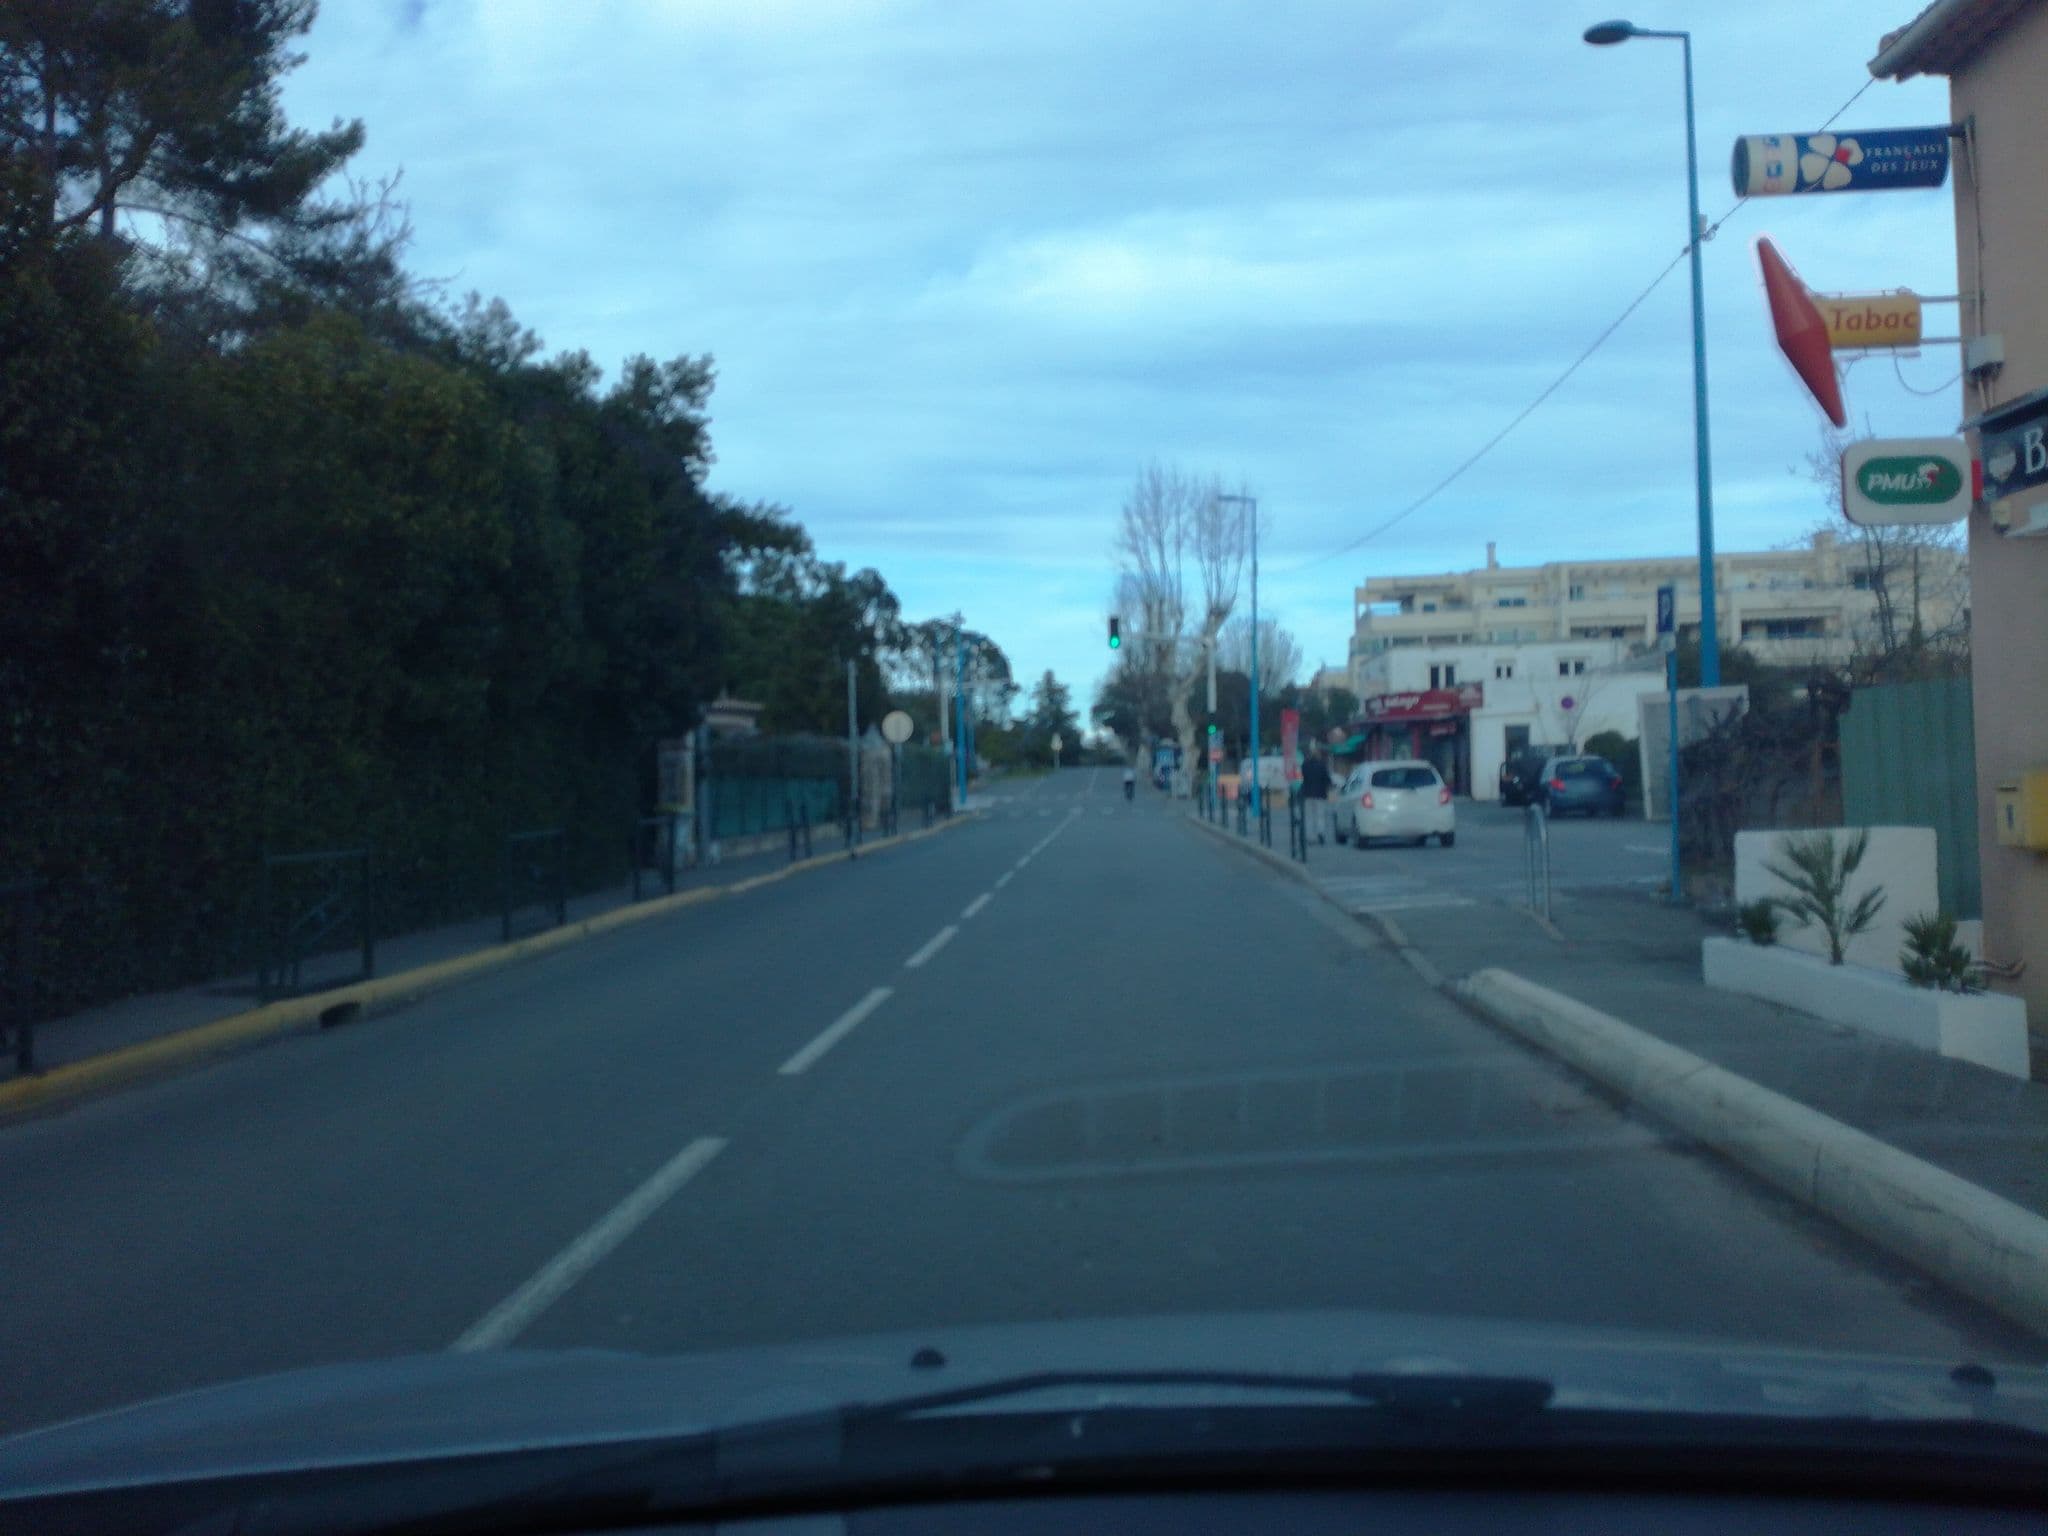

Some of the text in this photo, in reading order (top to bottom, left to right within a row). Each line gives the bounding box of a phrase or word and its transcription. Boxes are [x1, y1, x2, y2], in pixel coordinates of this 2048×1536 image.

[1871, 160, 1939, 173] DES JEUX
[1829, 304, 1918, 330] Tabac
[2024, 428, 2048, 474] B
[1867, 474, 1917, 491] PMU
